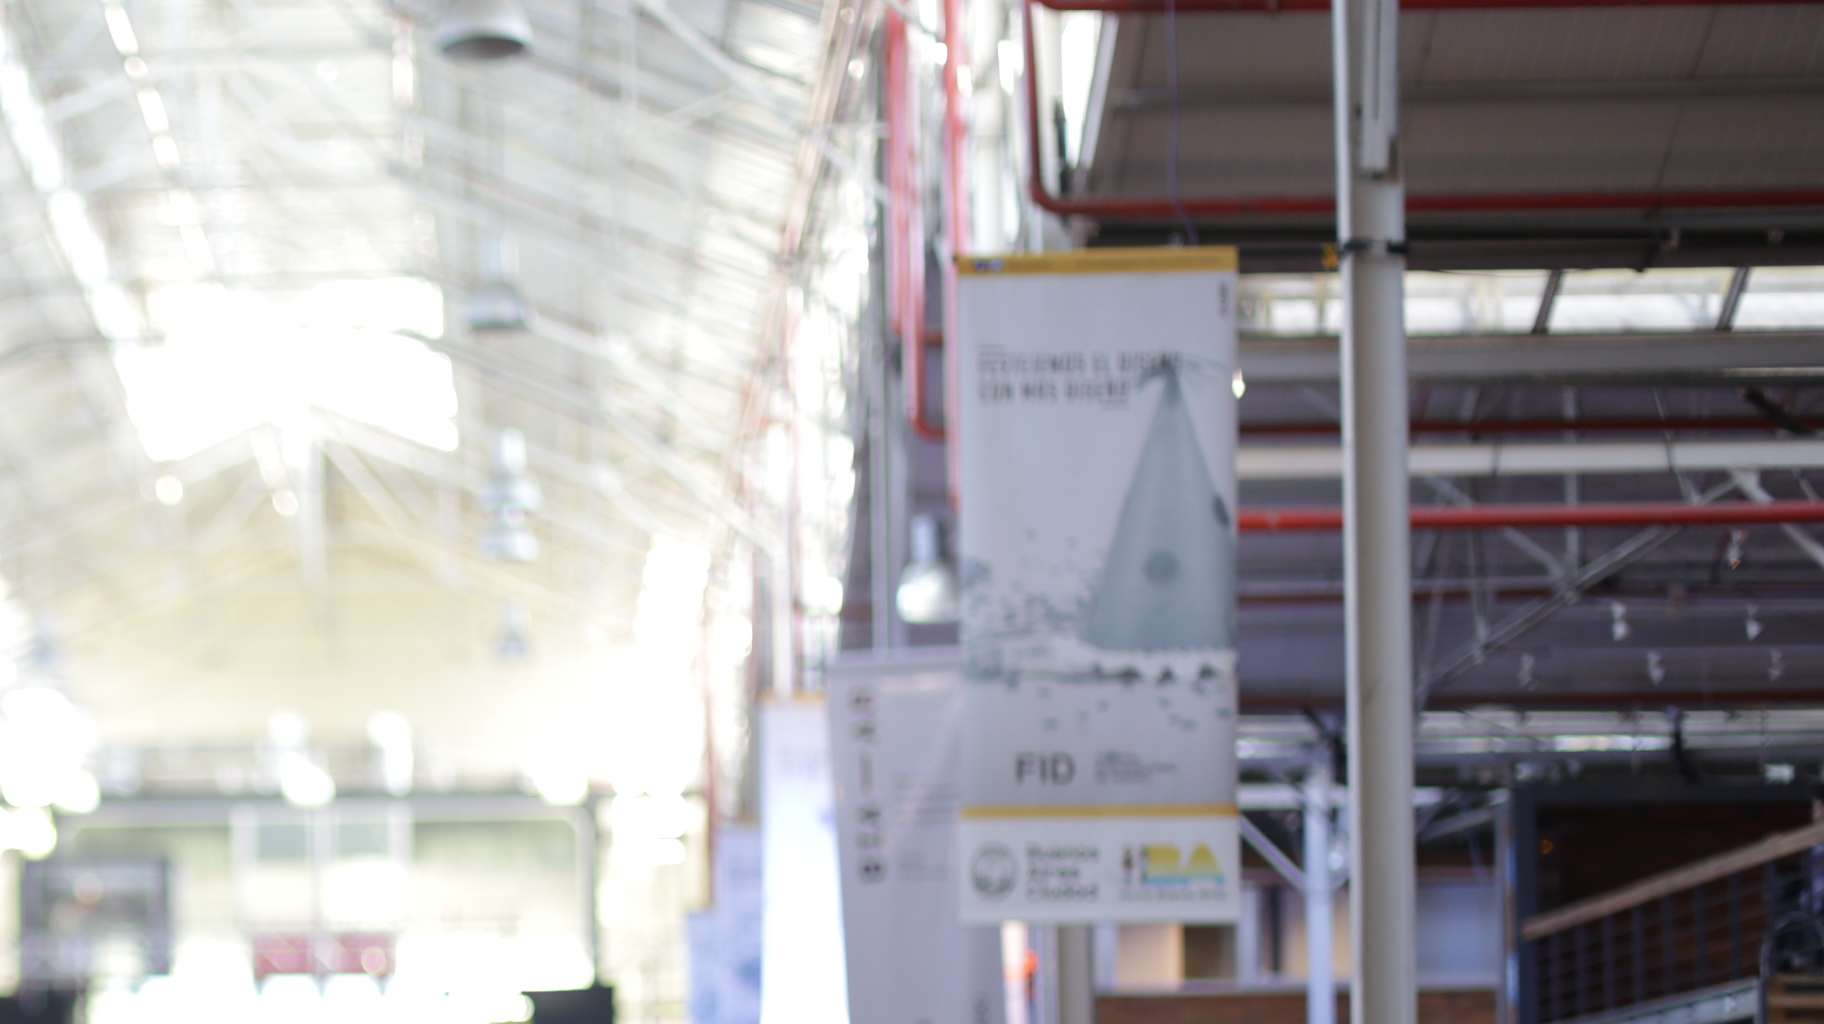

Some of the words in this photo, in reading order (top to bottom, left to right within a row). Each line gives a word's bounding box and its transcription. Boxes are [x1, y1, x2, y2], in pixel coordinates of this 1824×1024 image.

[1015, 752, 1077, 785] FID
[1027, 845, 1099, 861] Buenos
[1027, 864, 1080, 879] Aires
[1027, 884, 1098, 900] Ciudad
